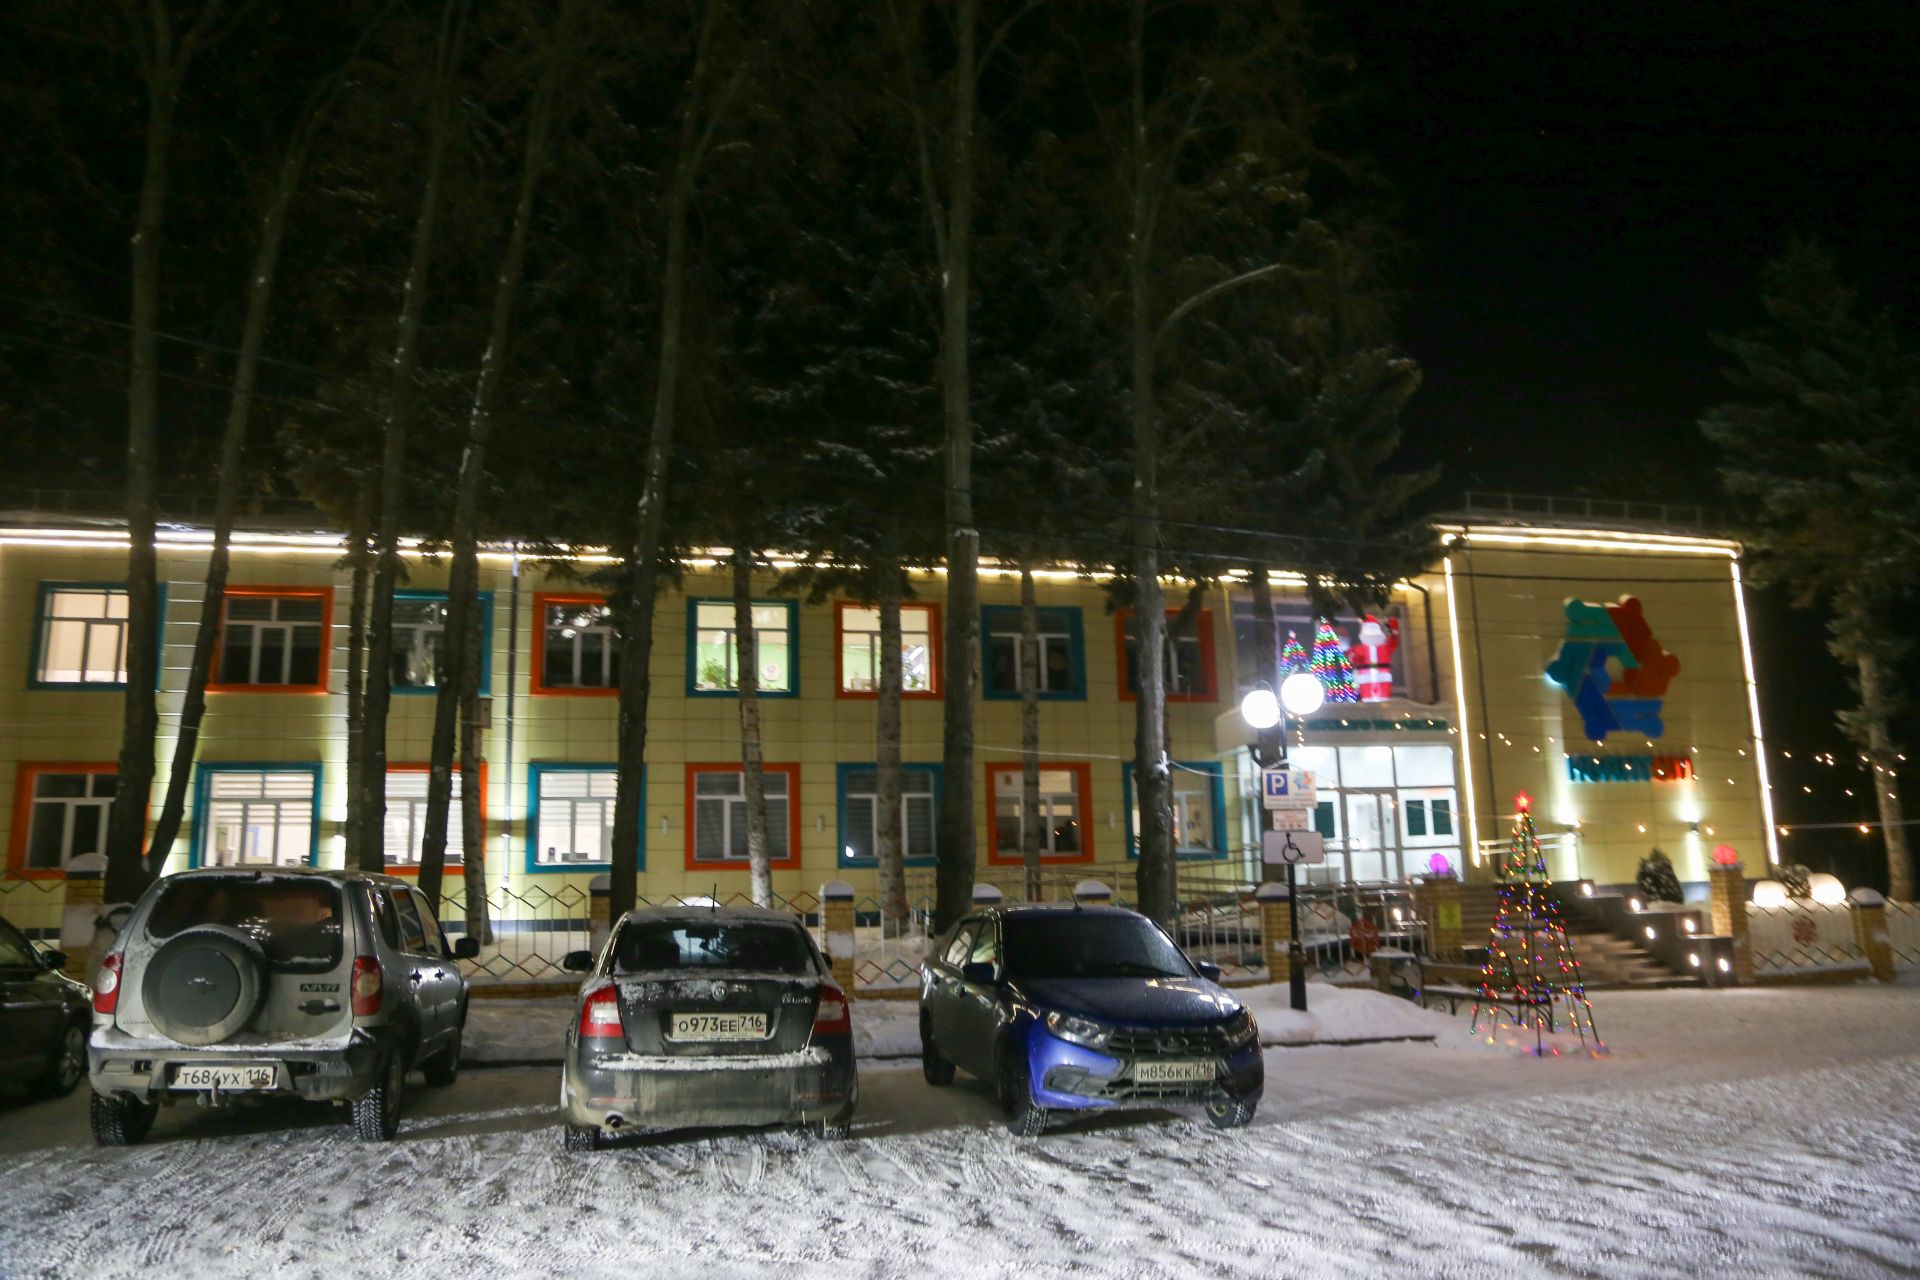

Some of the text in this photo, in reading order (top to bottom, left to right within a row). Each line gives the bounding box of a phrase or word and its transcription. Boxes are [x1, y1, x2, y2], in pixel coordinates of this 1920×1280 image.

[1271, 774, 1285, 794] P
[740, 1016, 762, 1028] 716
[246, 1068, 269, 1081] 116
[1195, 1063, 1213, 1075] 716
